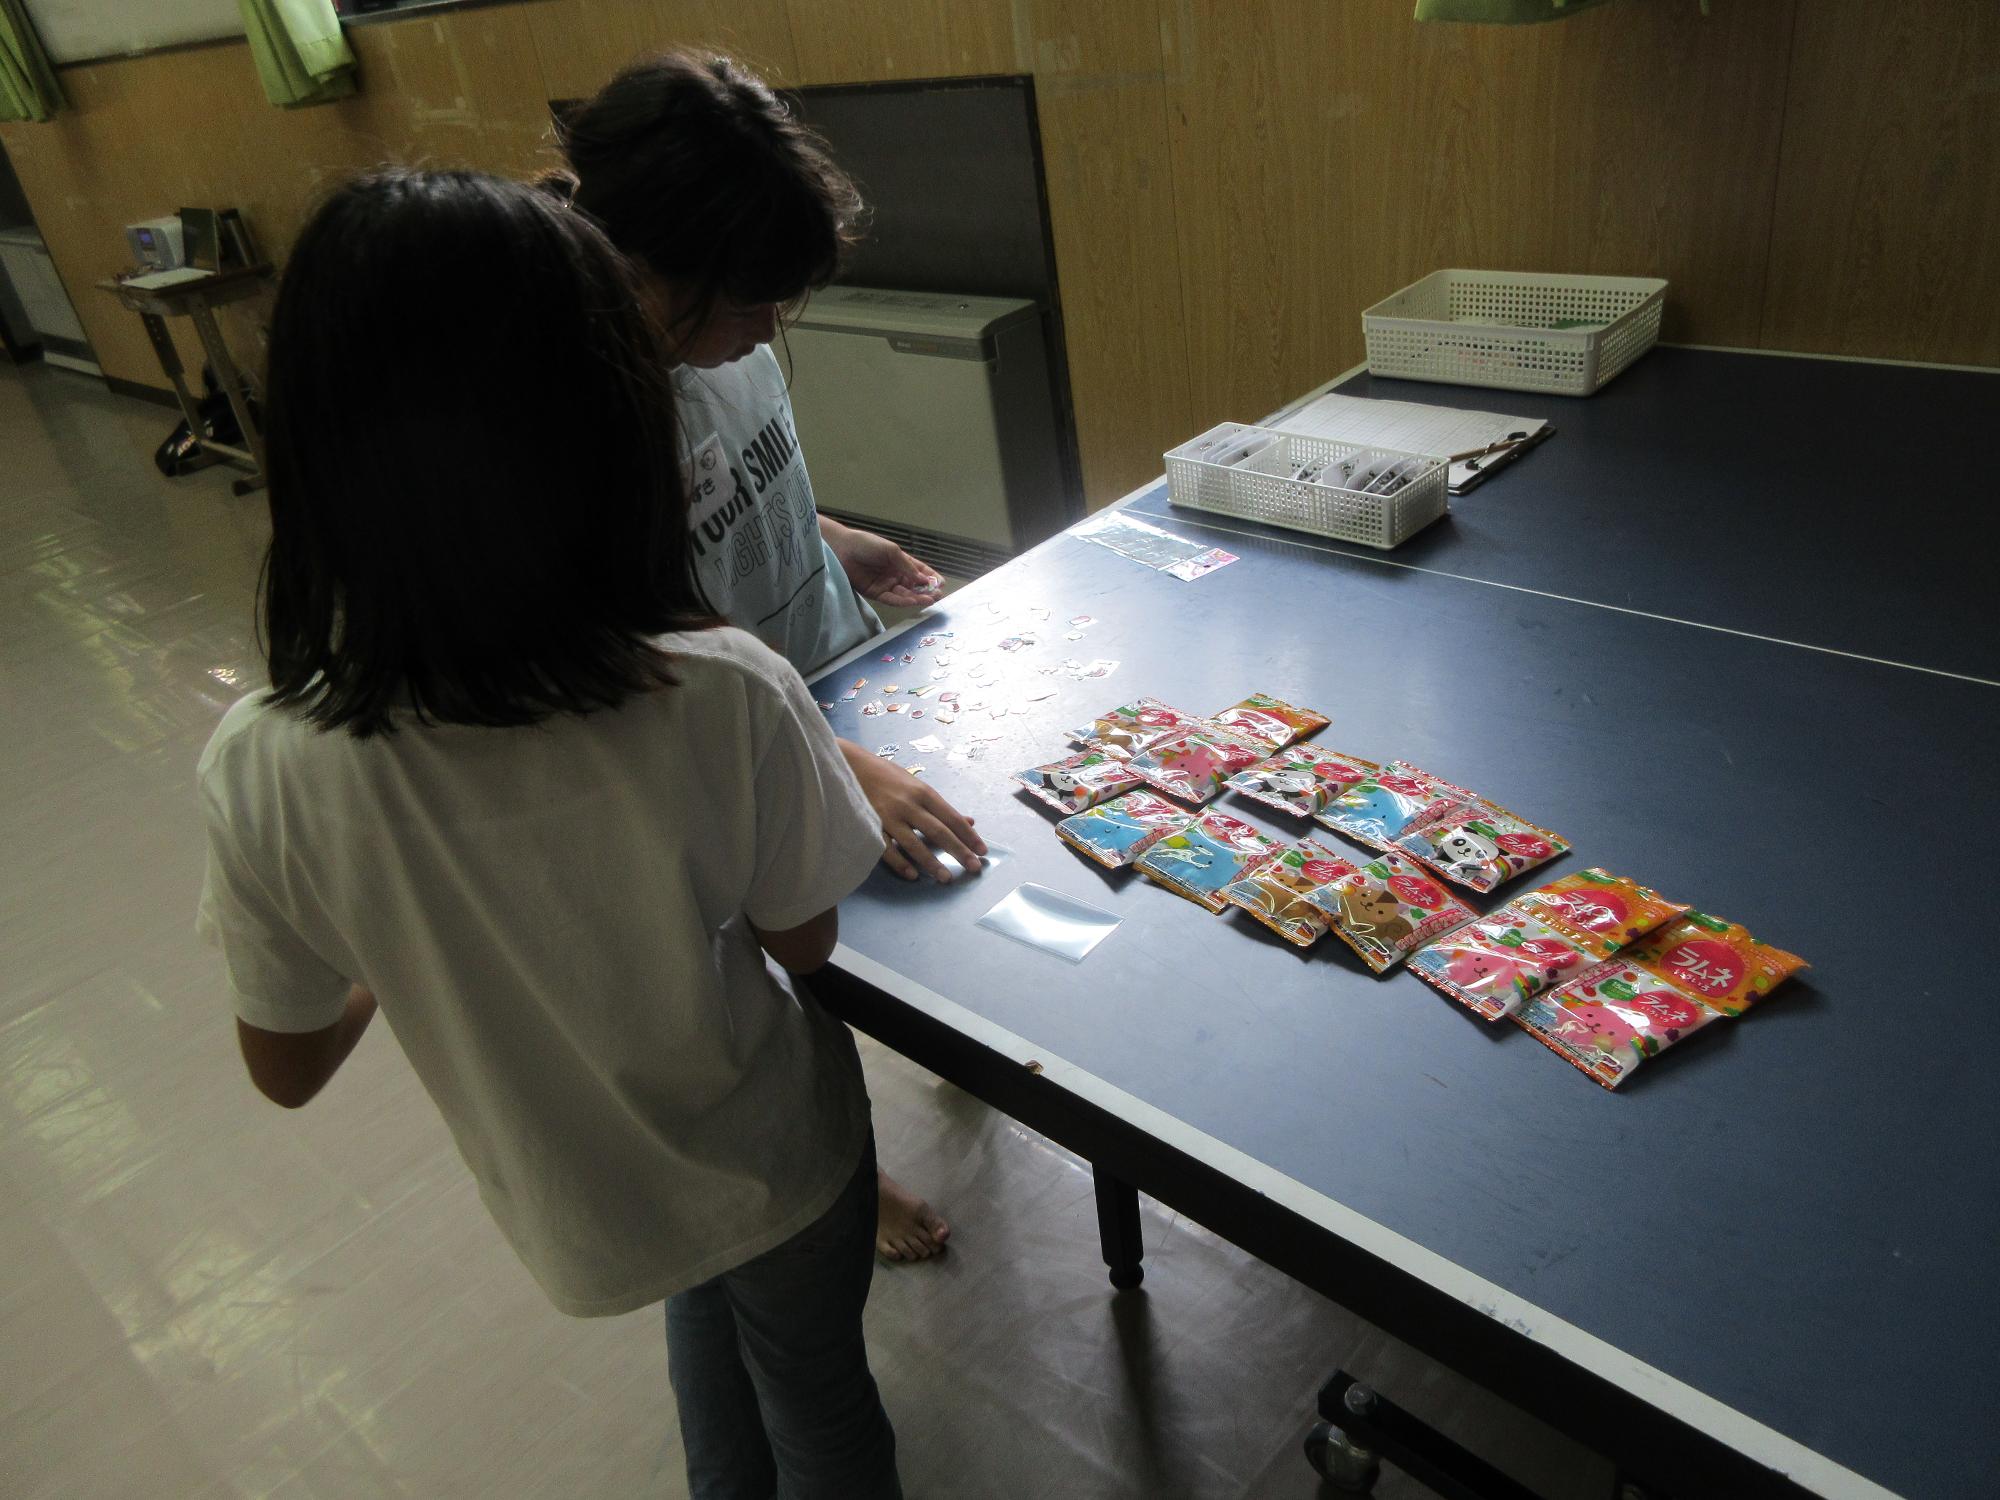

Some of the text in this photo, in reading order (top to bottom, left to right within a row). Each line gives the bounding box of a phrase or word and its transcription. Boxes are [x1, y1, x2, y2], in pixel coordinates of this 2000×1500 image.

[714, 491, 795, 592] LIGHTS
[1671, 946, 1734, 989] ラムネ
[1638, 994, 1689, 1023] ラムネ
